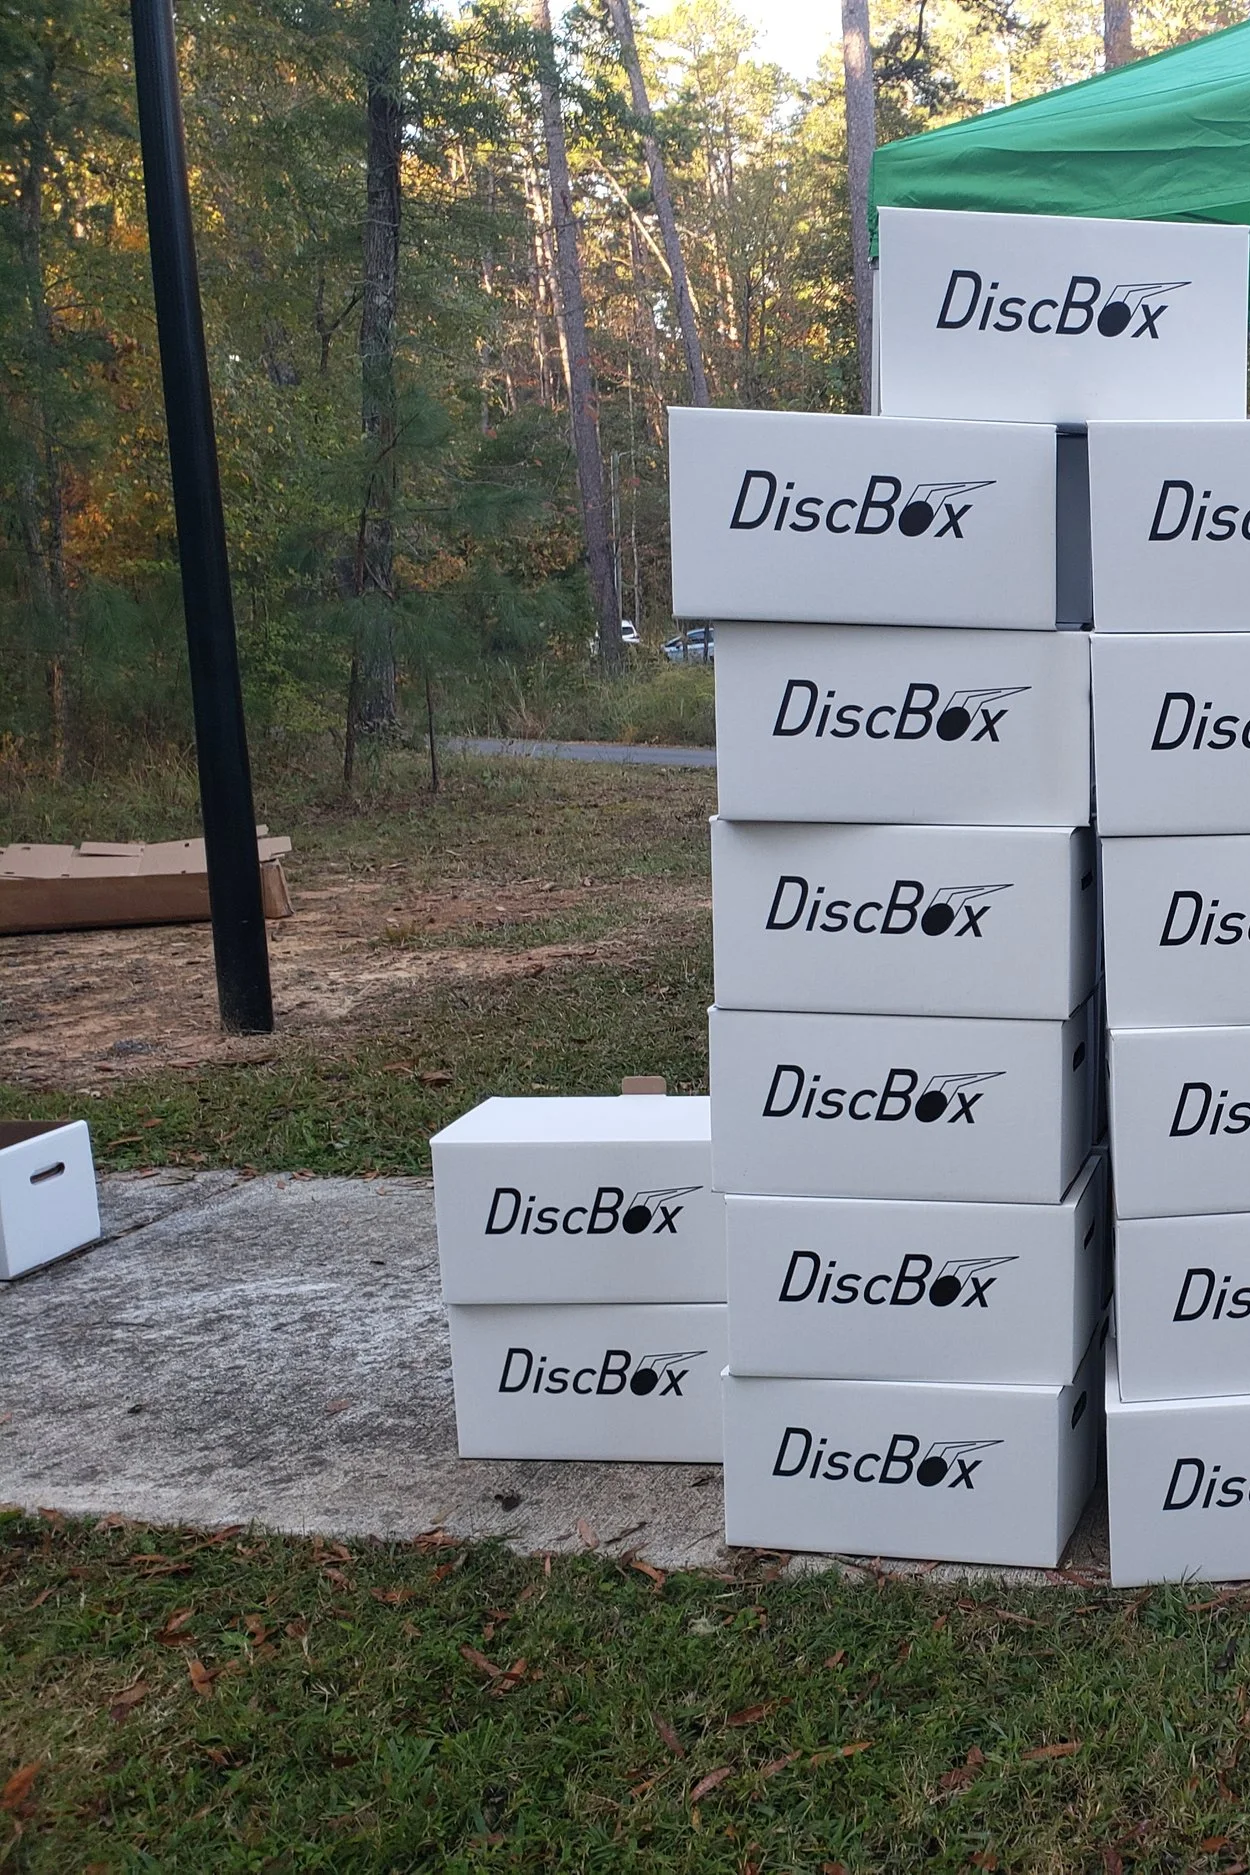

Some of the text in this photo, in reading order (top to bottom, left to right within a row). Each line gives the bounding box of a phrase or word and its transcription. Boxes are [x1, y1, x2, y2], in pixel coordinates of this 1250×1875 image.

[937, 270, 1168, 338] DiscBox
[730, 470, 972, 538] DiscBox
[773, 680, 1008, 741] DiscBox
[766, 876, 990, 937] DiscBox
[763, 1065, 983, 1123] DiscBox
[485, 1187, 683, 1234] DiscBox
[779, 1251, 997, 1307] DiscBox
[499, 1348, 689, 1396] DiscBox
[773, 1427, 982, 1489] DiscBox
